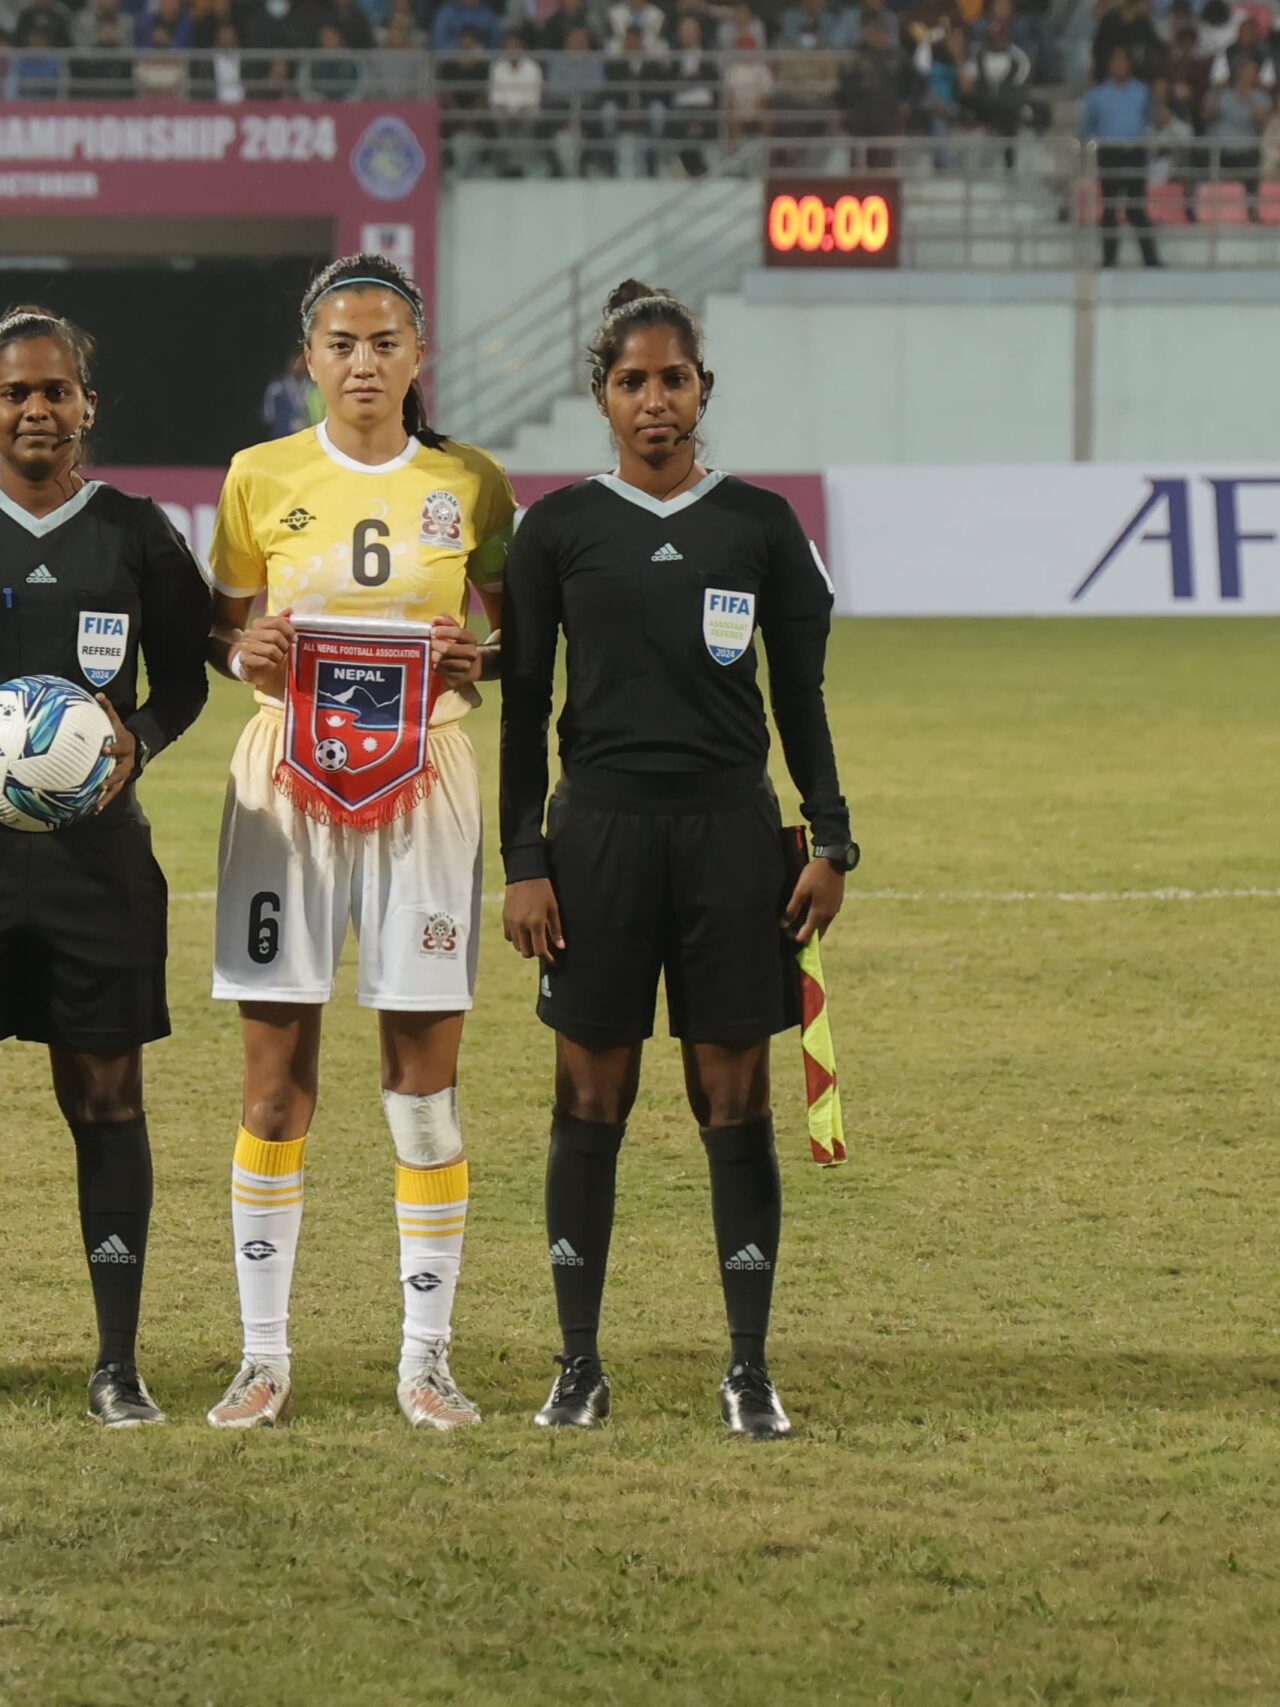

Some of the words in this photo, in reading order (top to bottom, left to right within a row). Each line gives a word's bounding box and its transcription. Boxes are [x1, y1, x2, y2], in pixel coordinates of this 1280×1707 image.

[240, 116, 337, 161] 2024
[768, 194, 889, 252] 00:00
[426, 491, 458, 507] BHUTAN
[352, 519, 391, 587] 6
[651, 553, 683, 562] adidas
[709, 594, 750, 615] FIFA
[84, 616, 124, 636] FIFA
[81, 645, 122, 657] REFEREE
[303, 643, 315, 652] ALL
[317, 644, 338, 654] NEPAL
[340, 645, 373, 657] FOOTBALL
[375, 648, 420, 658] ASSOCIATION
[716, 648, 735, 659] 2024
[91, 670, 110, 679] 2024
[333, 667, 386, 683] NEPAL
[248, 891, 280, 965] 6
[90, 1250, 137, 1264] adidas
[725, 1260, 770, 1270] adidas
